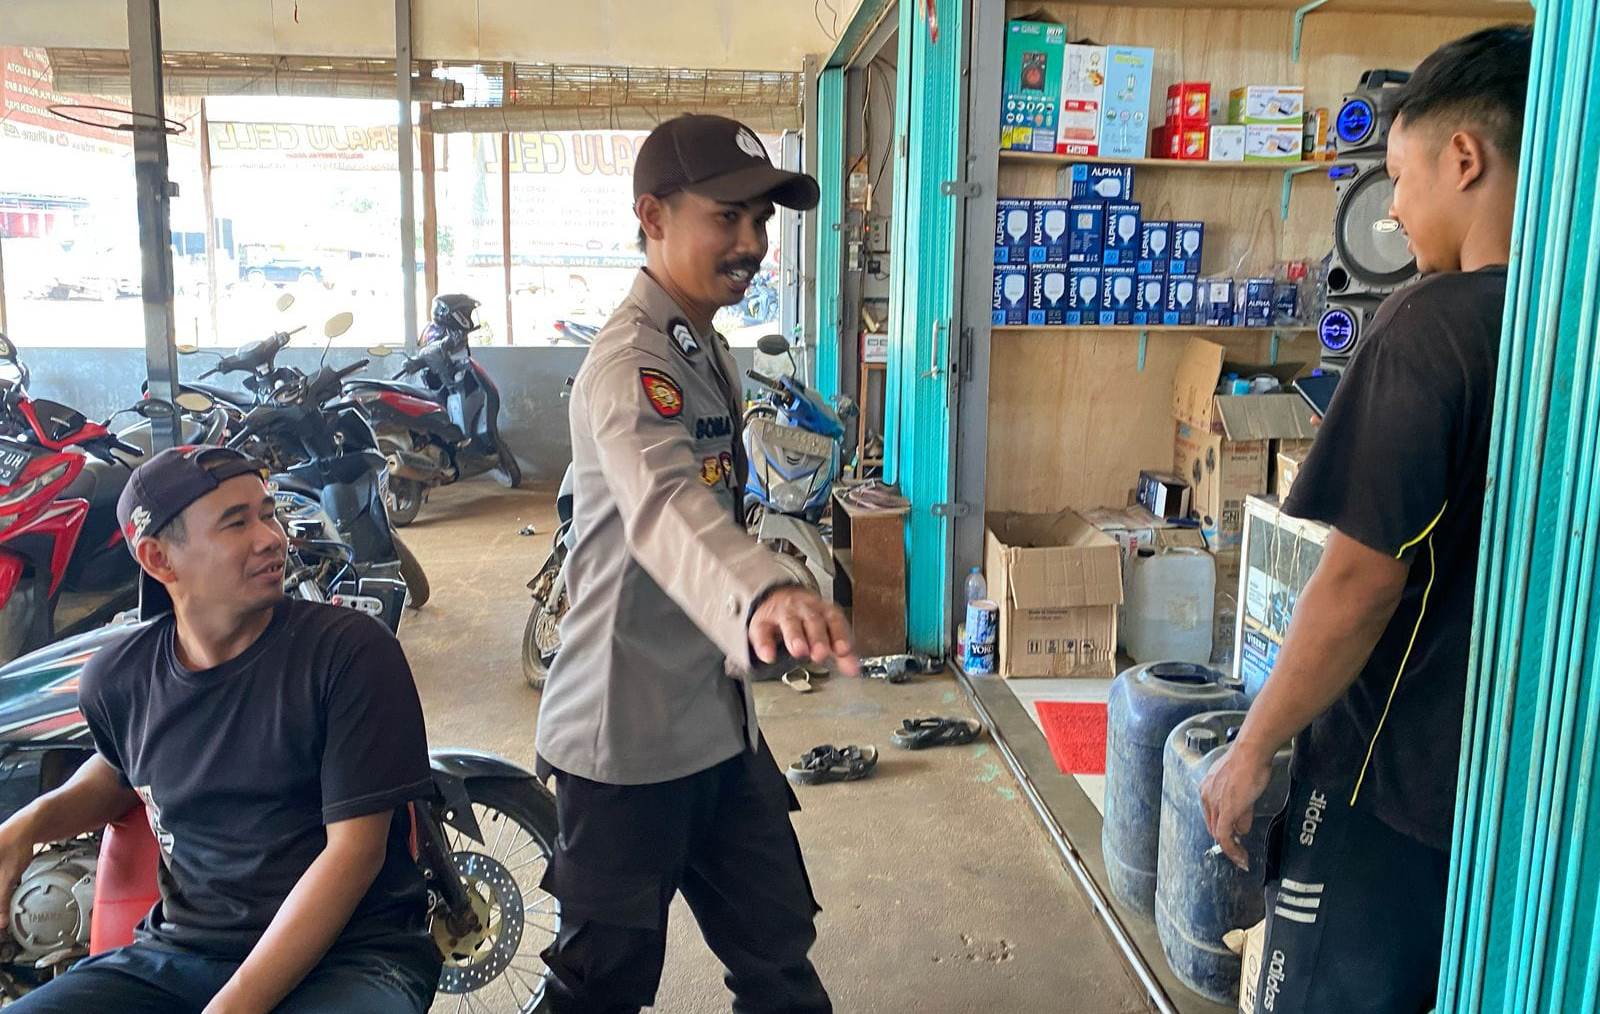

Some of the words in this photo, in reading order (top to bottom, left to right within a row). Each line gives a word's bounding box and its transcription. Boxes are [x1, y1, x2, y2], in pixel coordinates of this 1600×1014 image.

[1091, 167, 1122, 177] ALPHA
[996, 210, 1006, 246] ALPHA
[1033, 210, 1044, 246] ALPHA
[1108, 214, 1117, 247] ALPHA
[1142, 229, 1150, 259] ALPHA
[1174, 229, 1183, 259] ALPHA
[993, 273, 1003, 309] ALPHA
[1032, 273, 1042, 309] ALPHA
[1069, 276, 1078, 308] ALPHA
[1103, 276, 1112, 308] ALPHA
[1136, 281, 1145, 310] ALPHA
[1168, 281, 1177, 310] ALPHA
[4, 453, 24, 468] UH
[1223, 511, 1240, 522] SNI
[1300, 790, 1327, 847] didas
[1264, 950, 1285, 1013] adidas
